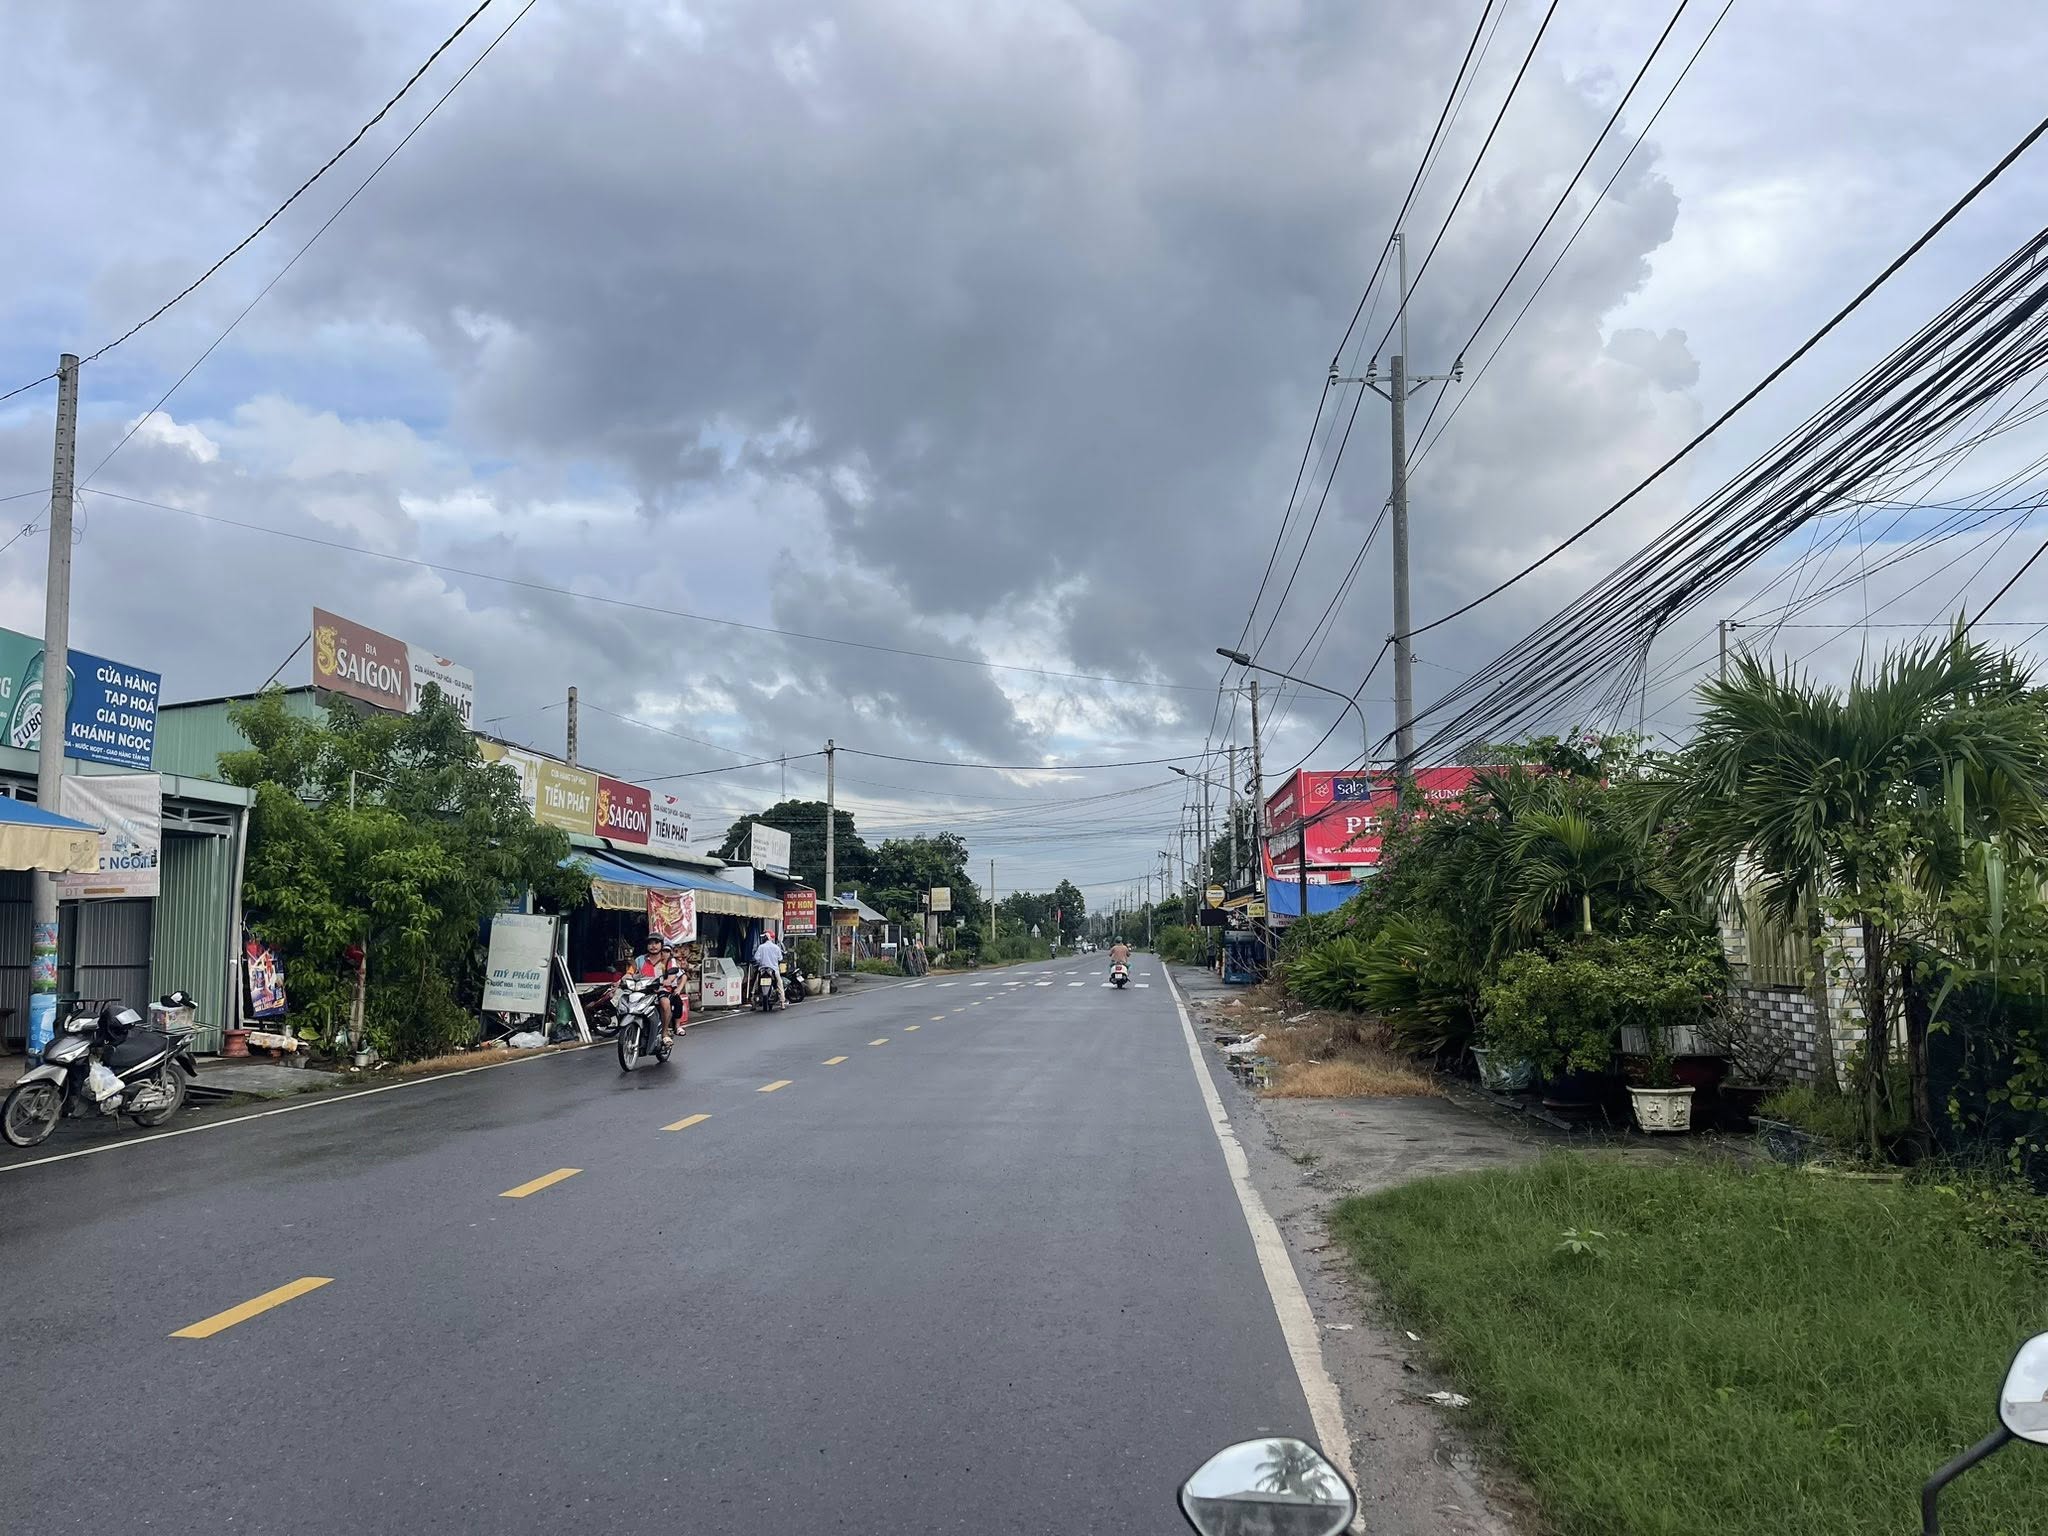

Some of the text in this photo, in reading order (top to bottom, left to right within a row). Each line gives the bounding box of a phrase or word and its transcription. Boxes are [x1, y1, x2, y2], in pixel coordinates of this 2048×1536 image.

[365, 643, 377, 657] BIA
[96, 666, 158, 695] CỬA HÀNG
[336, 648, 402, 696] SAIGON
[104, 689, 155, 714] TẠP HOÁ
[14, 709, 42, 746] TUBO
[96, 708, 154, 733] GIA DỤNG
[71, 722, 152, 753] KHÁNH NGỌC
[545, 783, 566, 808] TIẾN
[567, 791, 591, 814] PHÁT
[608, 804, 647, 832] SAIGON
[655, 816, 689, 843] TIẾN PHÁT
[493, 969, 540, 980] MỸ PHẨM
